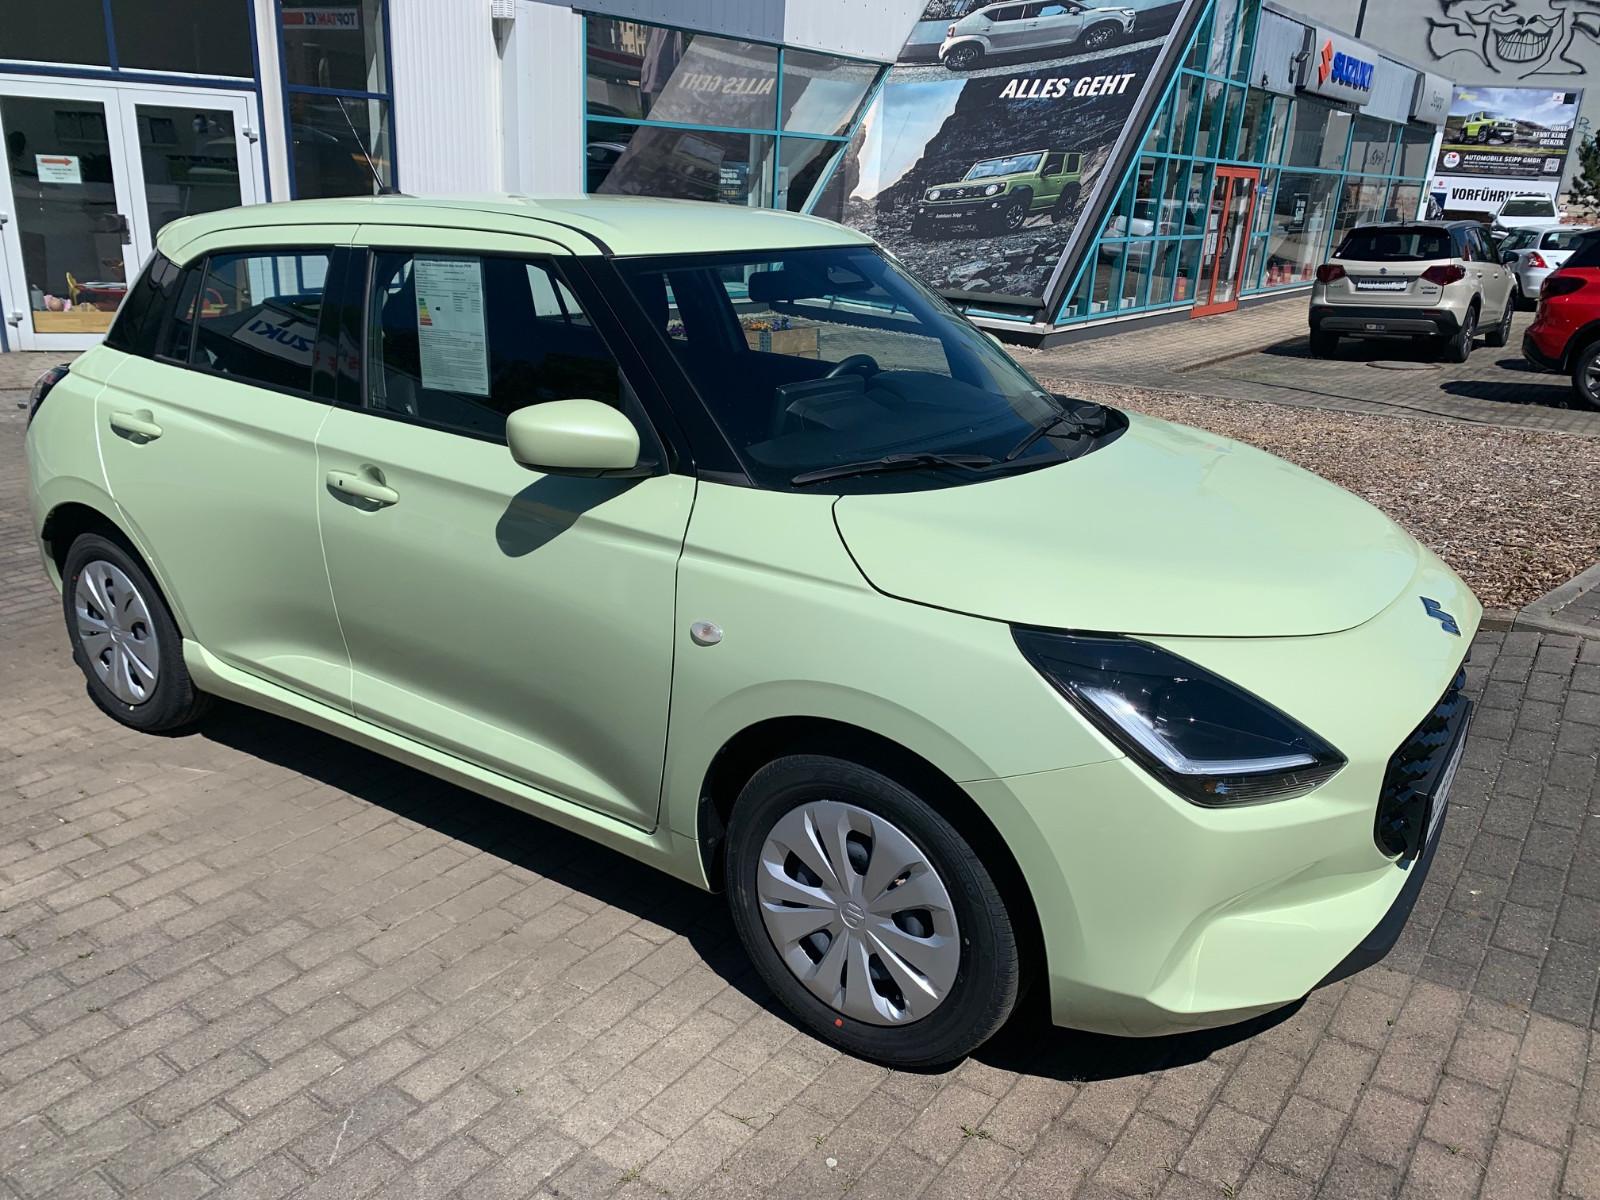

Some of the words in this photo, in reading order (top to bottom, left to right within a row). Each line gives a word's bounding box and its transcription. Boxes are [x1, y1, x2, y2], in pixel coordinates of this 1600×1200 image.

[1331, 52, 1374, 90] SUZUKI
[999, 78, 1070, 98] ALLES
[1073, 73, 1136, 97] GEHT
[1464, 154, 1503, 162] AUTOMOBILE
